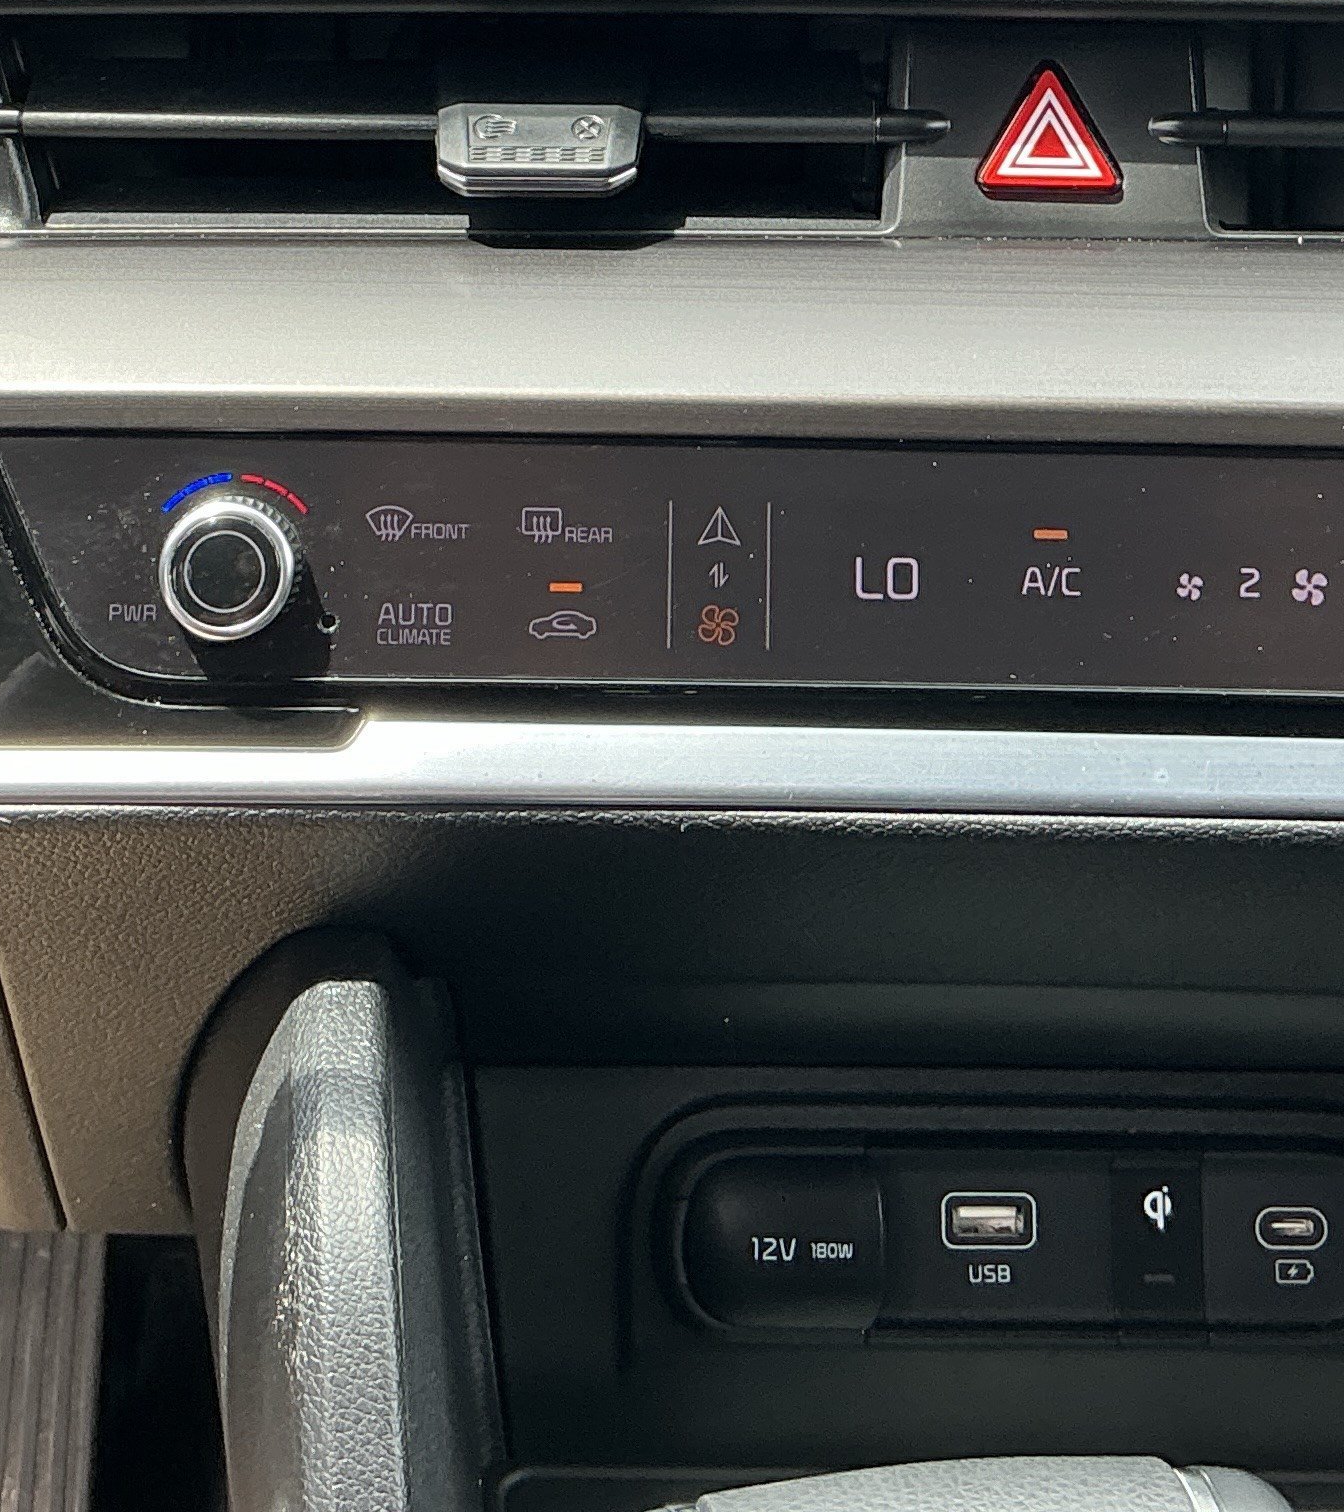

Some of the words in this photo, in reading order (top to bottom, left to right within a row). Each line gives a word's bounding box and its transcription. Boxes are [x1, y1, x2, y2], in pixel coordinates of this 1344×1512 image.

[410, 521, 470, 540] FRONT
[564, 526, 613, 543] REAR
[855, 556, 919, 600] LO
[1021, 566, 1082, 597] A/C
[1239, 567, 1261, 598] 2
[108, 603, 157, 622] PWR
[377, 602, 453, 626] AUTO
[376, 628, 452, 646] CLIMATE
[751, 1236, 797, 1262] 12V
[810, 1242, 854, 1260] 180W
[968, 1264, 1011, 1284] USB
